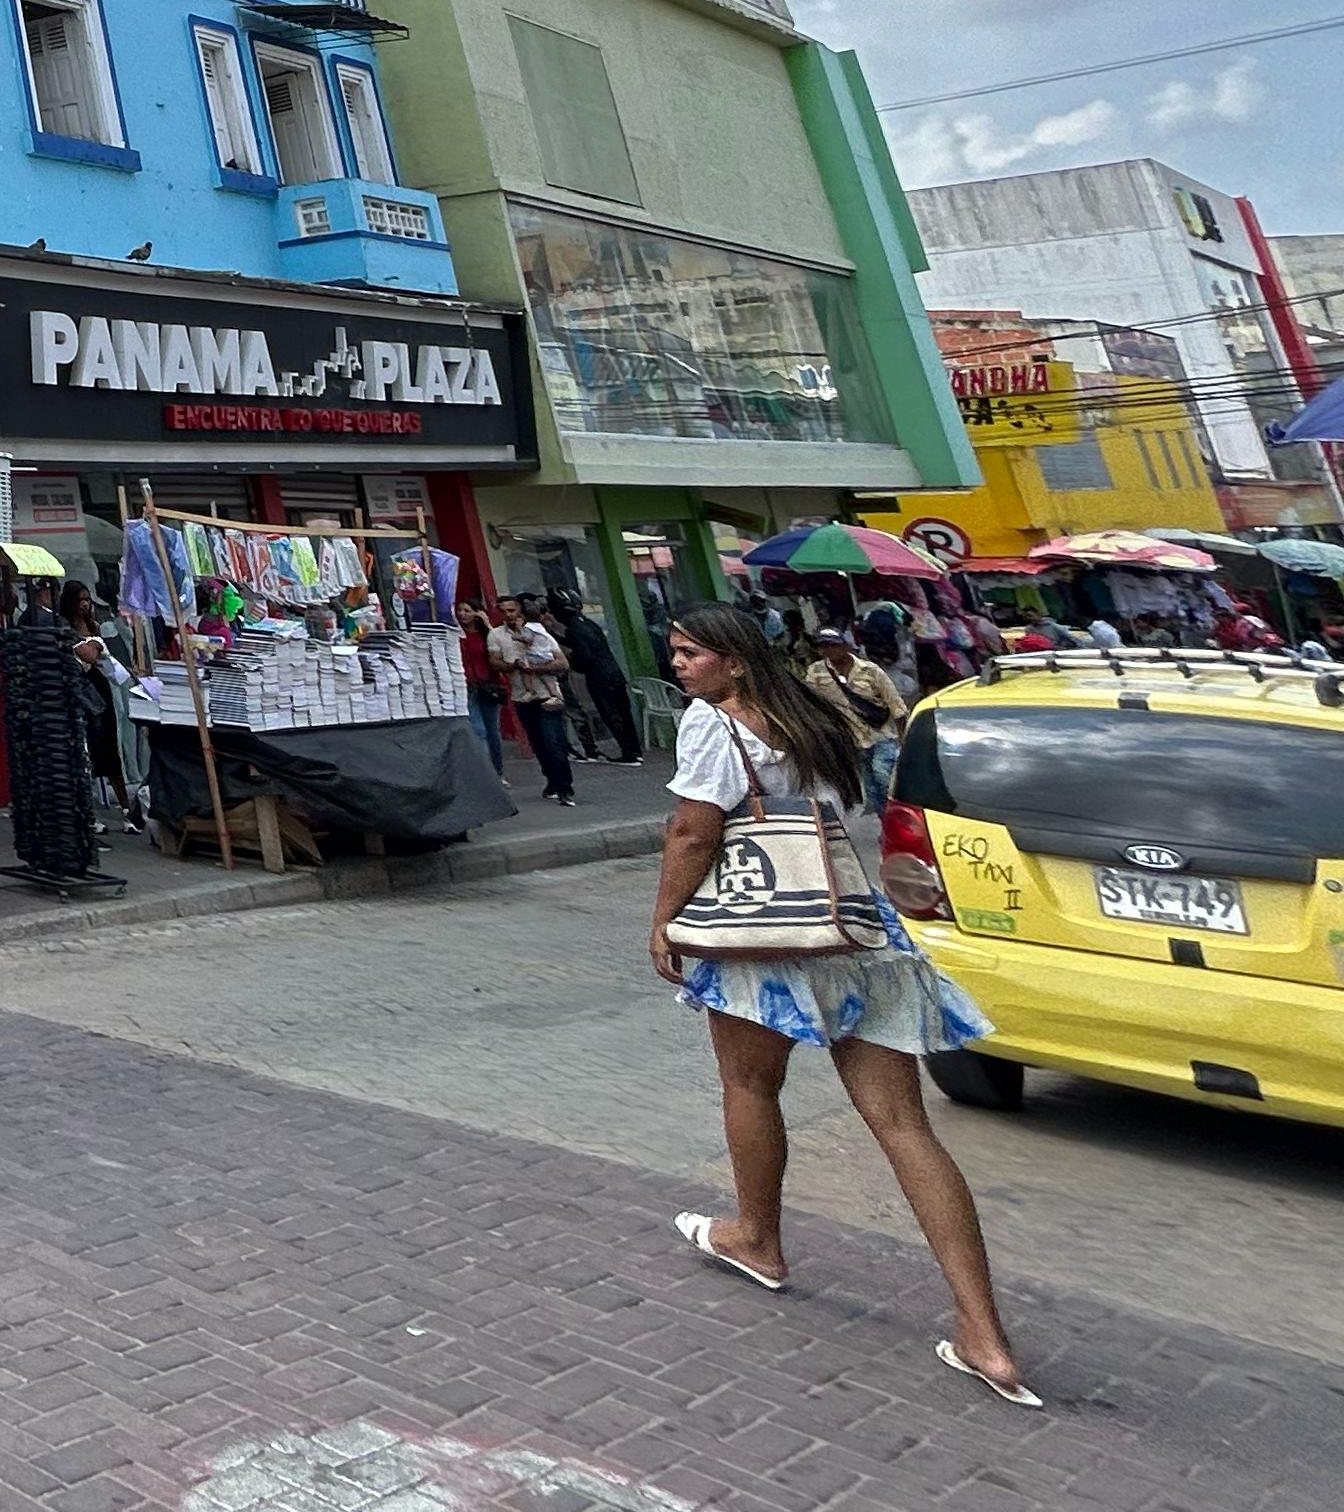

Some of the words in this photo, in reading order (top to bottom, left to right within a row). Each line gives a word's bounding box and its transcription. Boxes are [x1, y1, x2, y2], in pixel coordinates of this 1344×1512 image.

[29, 310, 279, 396] PANAMA
[362, 340, 502, 405] PLAZA
[173, 405, 284, 430] ENCUENTRA
[290, 409, 312, 431] LO
[321, 410, 353, 432] QUE
[357, 410, 422, 433] QUIERAS
[941, 834, 989, 859] EKO
[1132, 848, 1176, 865] KIA
[968, 860, 1014, 885] TAXI
[1100, 868, 1235, 918] STK-749
